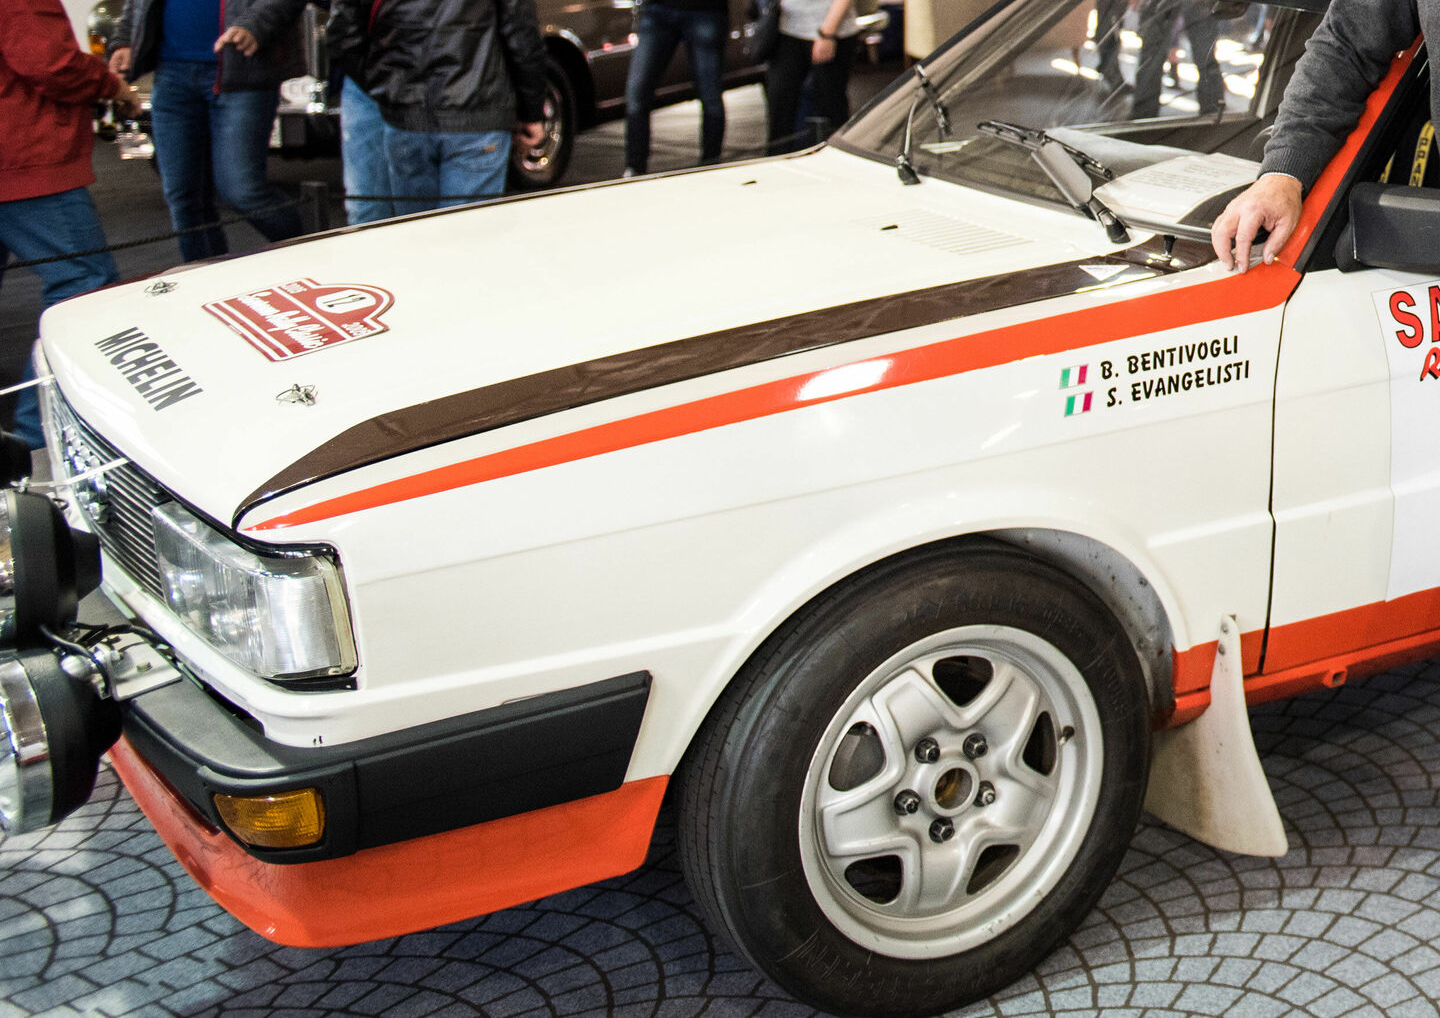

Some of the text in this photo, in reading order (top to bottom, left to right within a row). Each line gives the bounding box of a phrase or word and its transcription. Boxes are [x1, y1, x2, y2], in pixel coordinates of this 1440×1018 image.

[94, 326, 204, 412] MICHELIN
[1100, 335, 1238, 380] B. BENTIVOGLI
[1107, 360, 1249, 407] S. EVANGELISTI
